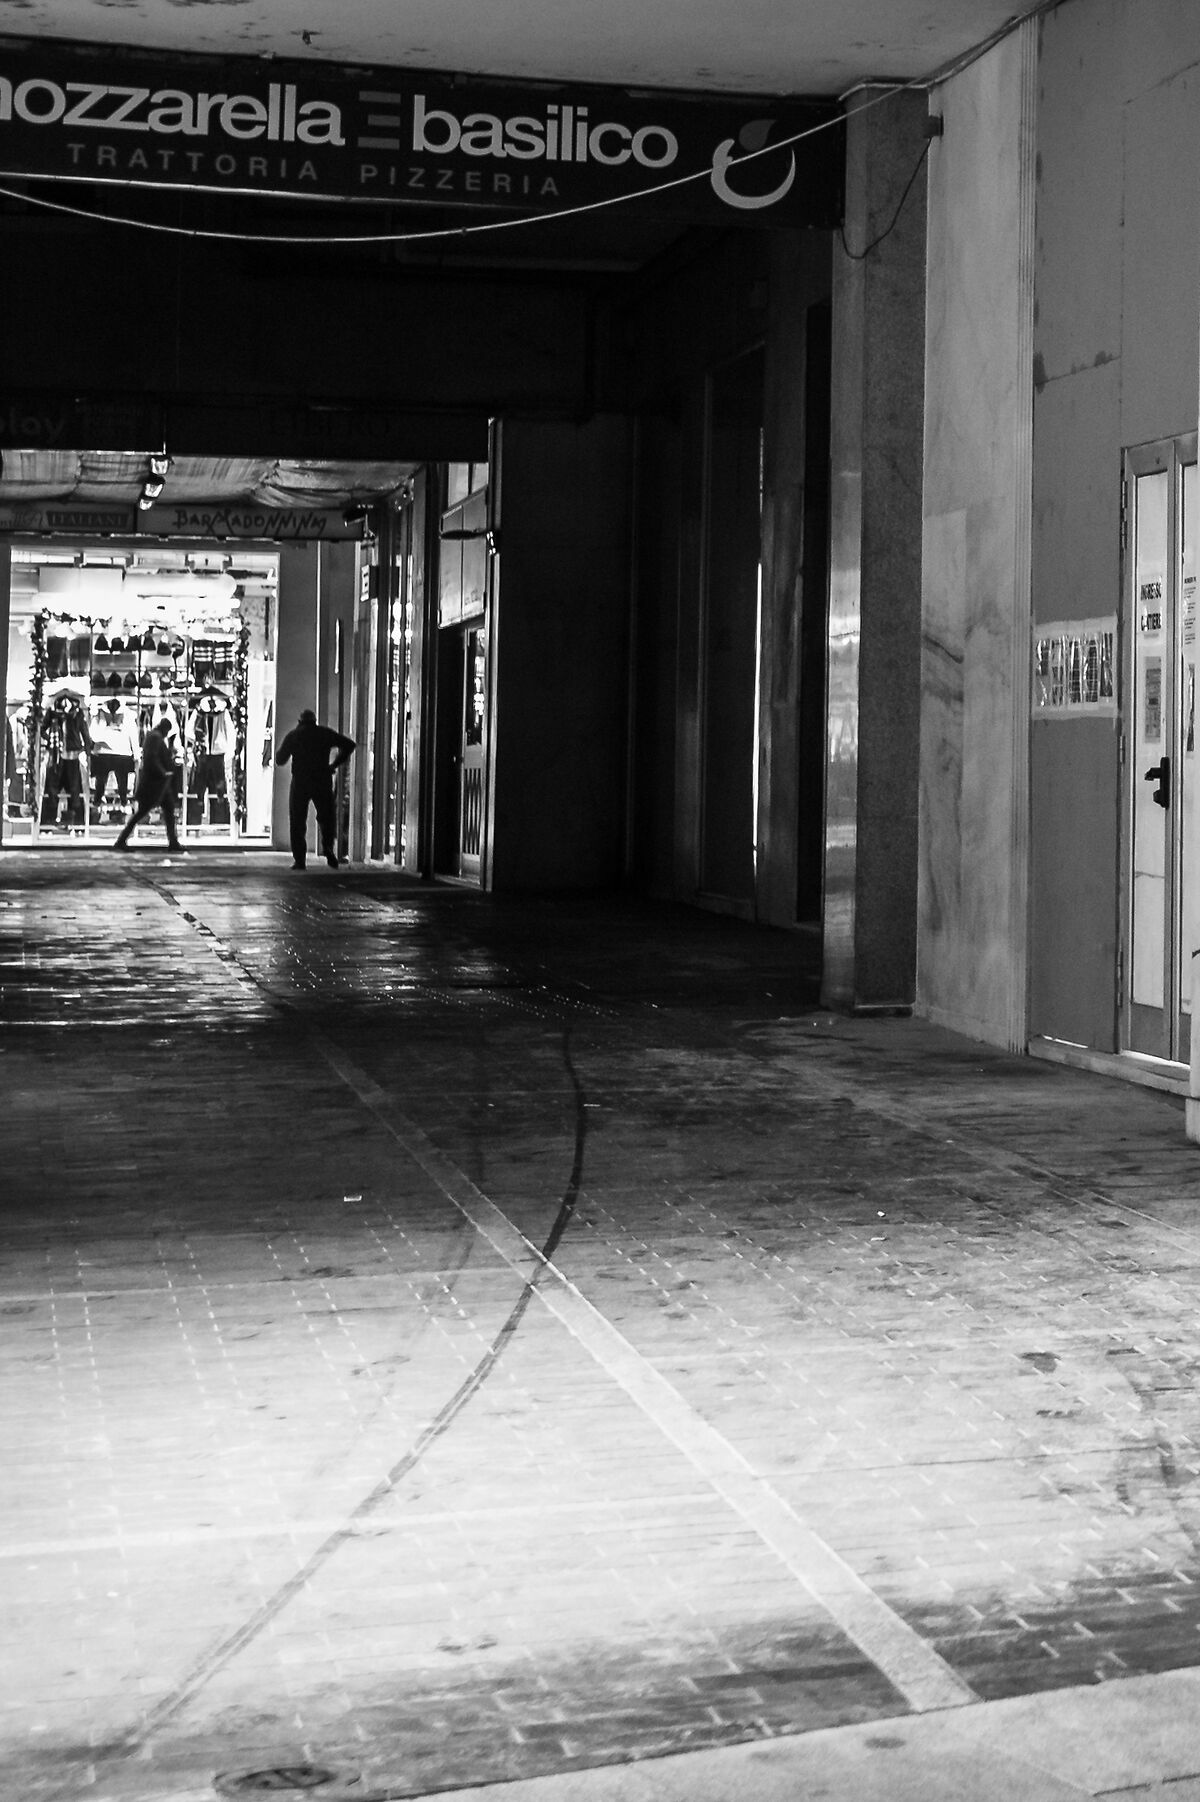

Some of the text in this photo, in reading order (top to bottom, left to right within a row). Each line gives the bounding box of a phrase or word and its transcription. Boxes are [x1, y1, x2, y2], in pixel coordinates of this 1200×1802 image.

[0, 76, 346, 146] ozzarella
[412, 94, 679, 168] basilico
[67, 144, 560, 196] TRATTORIA PIZZERIA
[0, 407, 66, 444] lay
